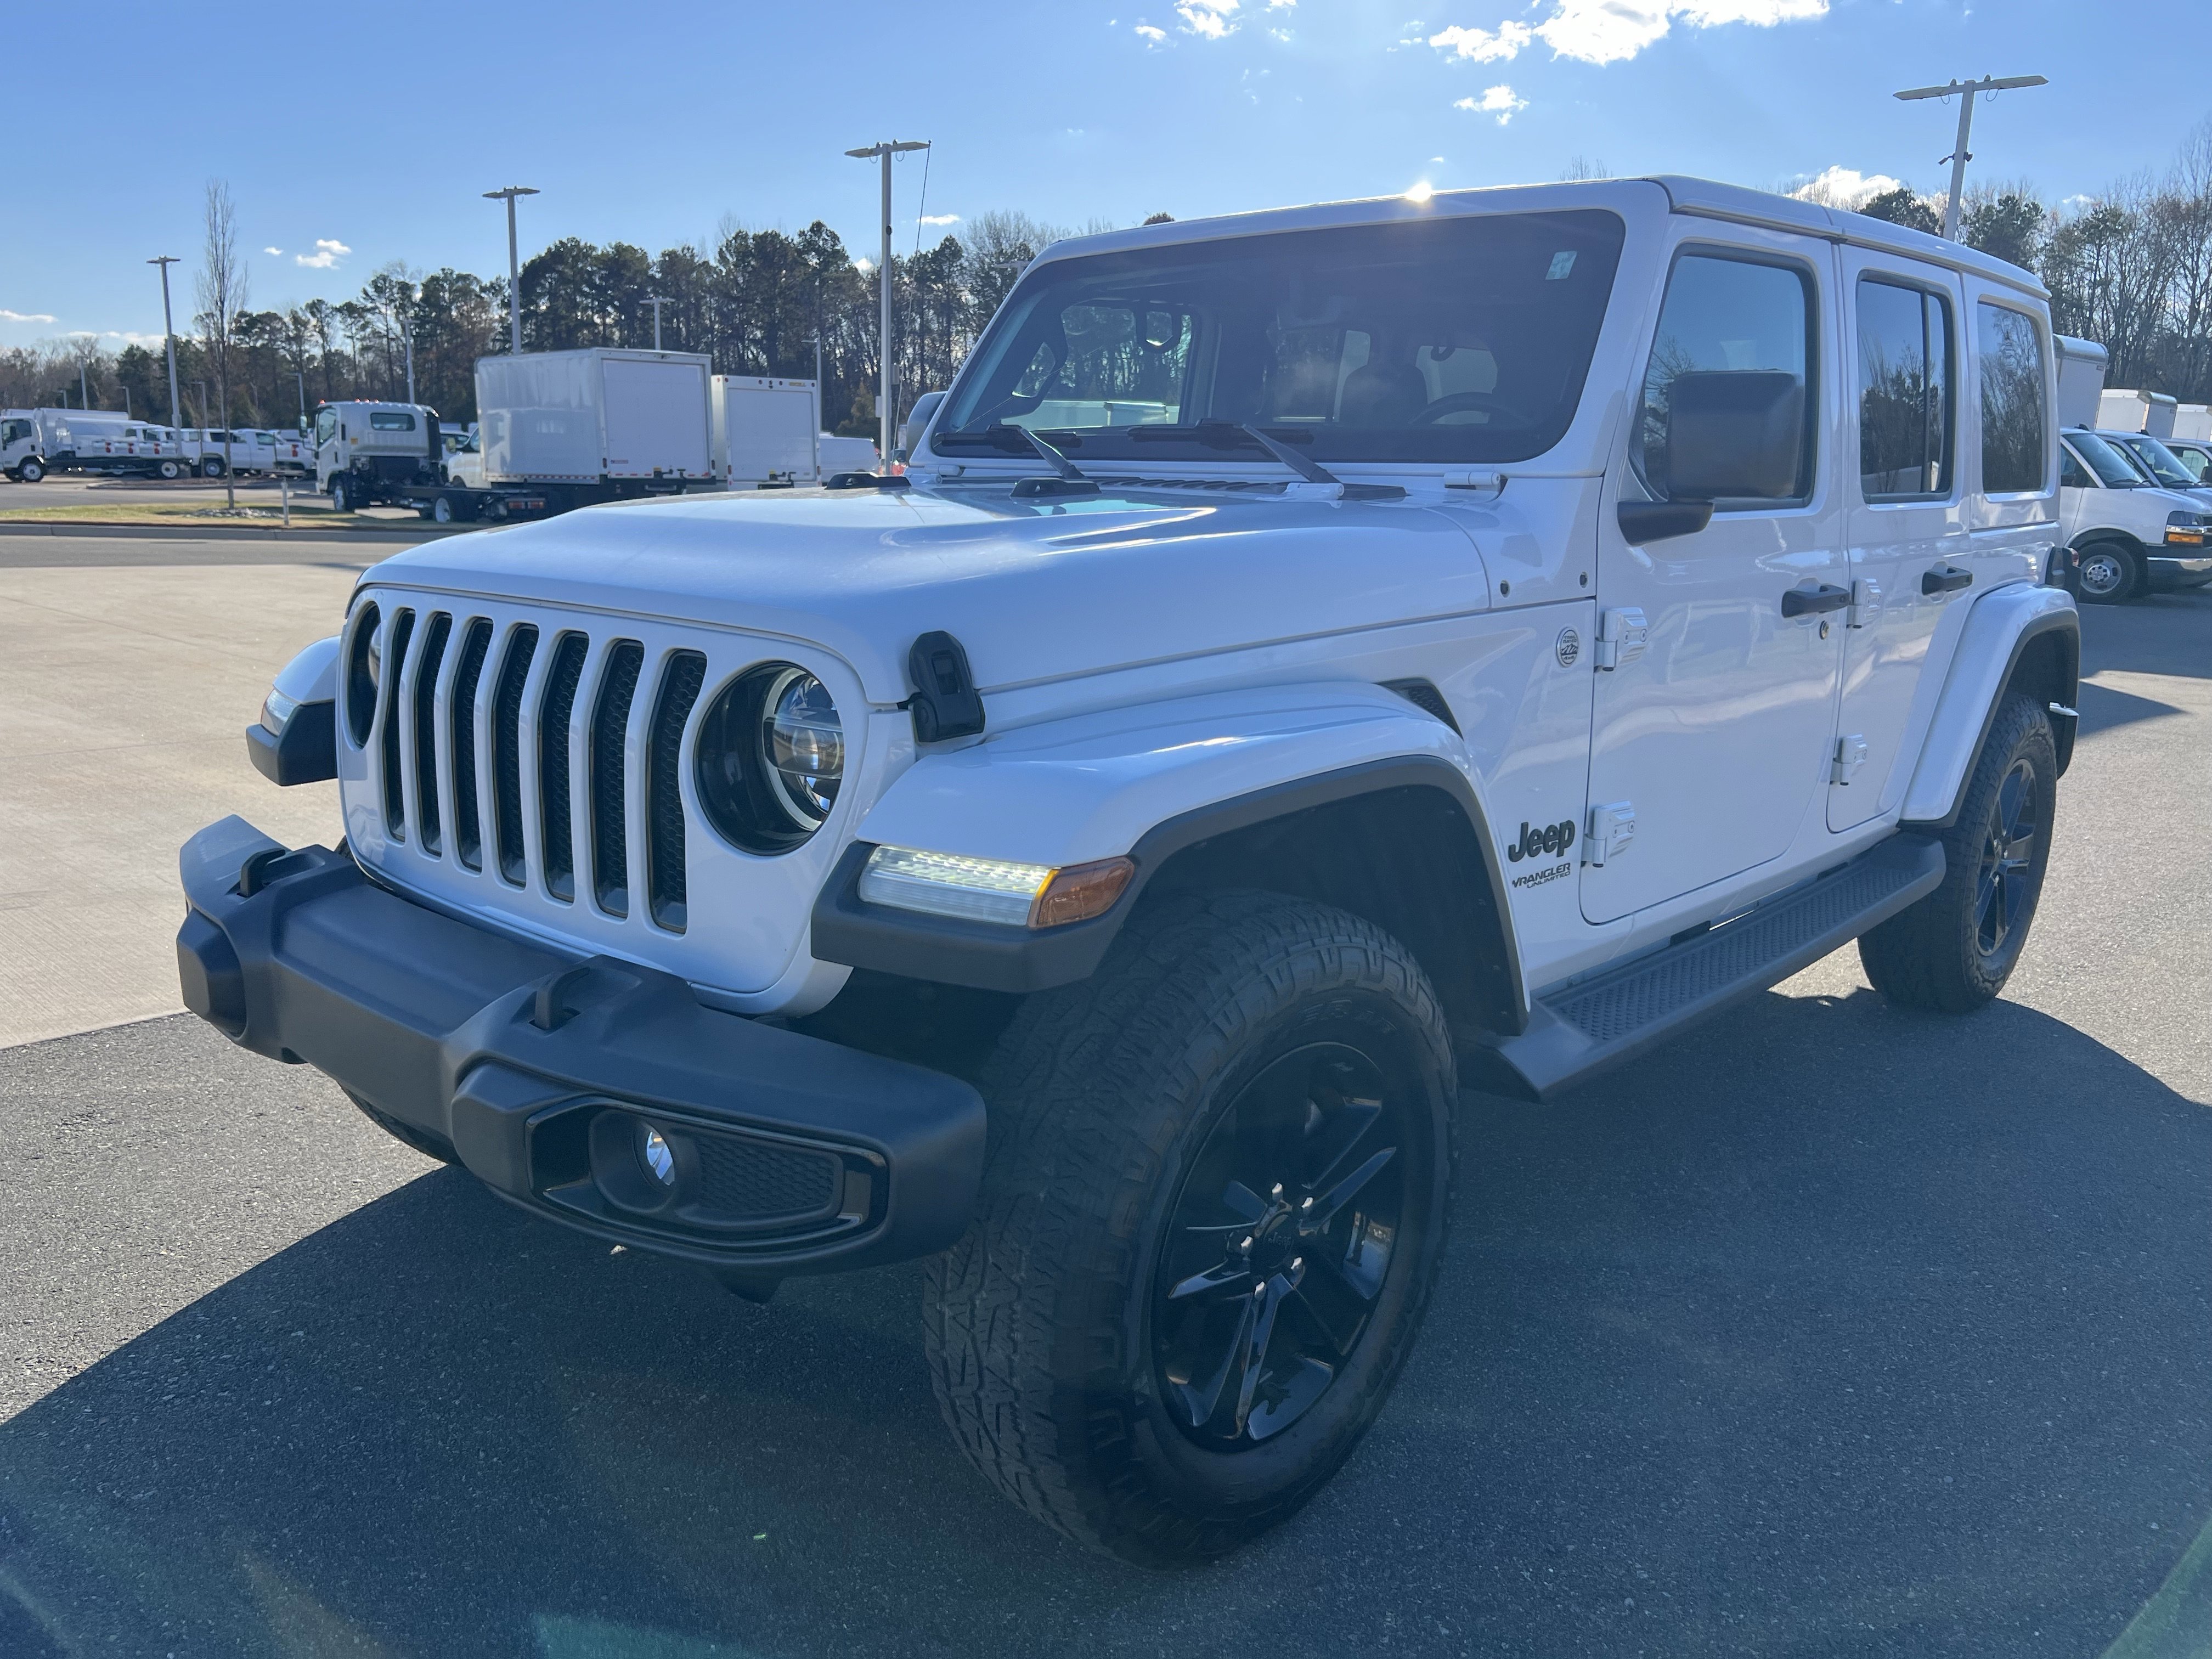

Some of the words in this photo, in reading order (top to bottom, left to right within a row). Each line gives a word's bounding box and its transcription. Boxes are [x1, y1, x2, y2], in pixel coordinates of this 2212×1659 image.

[1508, 820, 1576, 863] Jeep
[1512, 862, 1571, 888] WRANGLER
[1527, 871, 1571, 889] UNLIMITED
